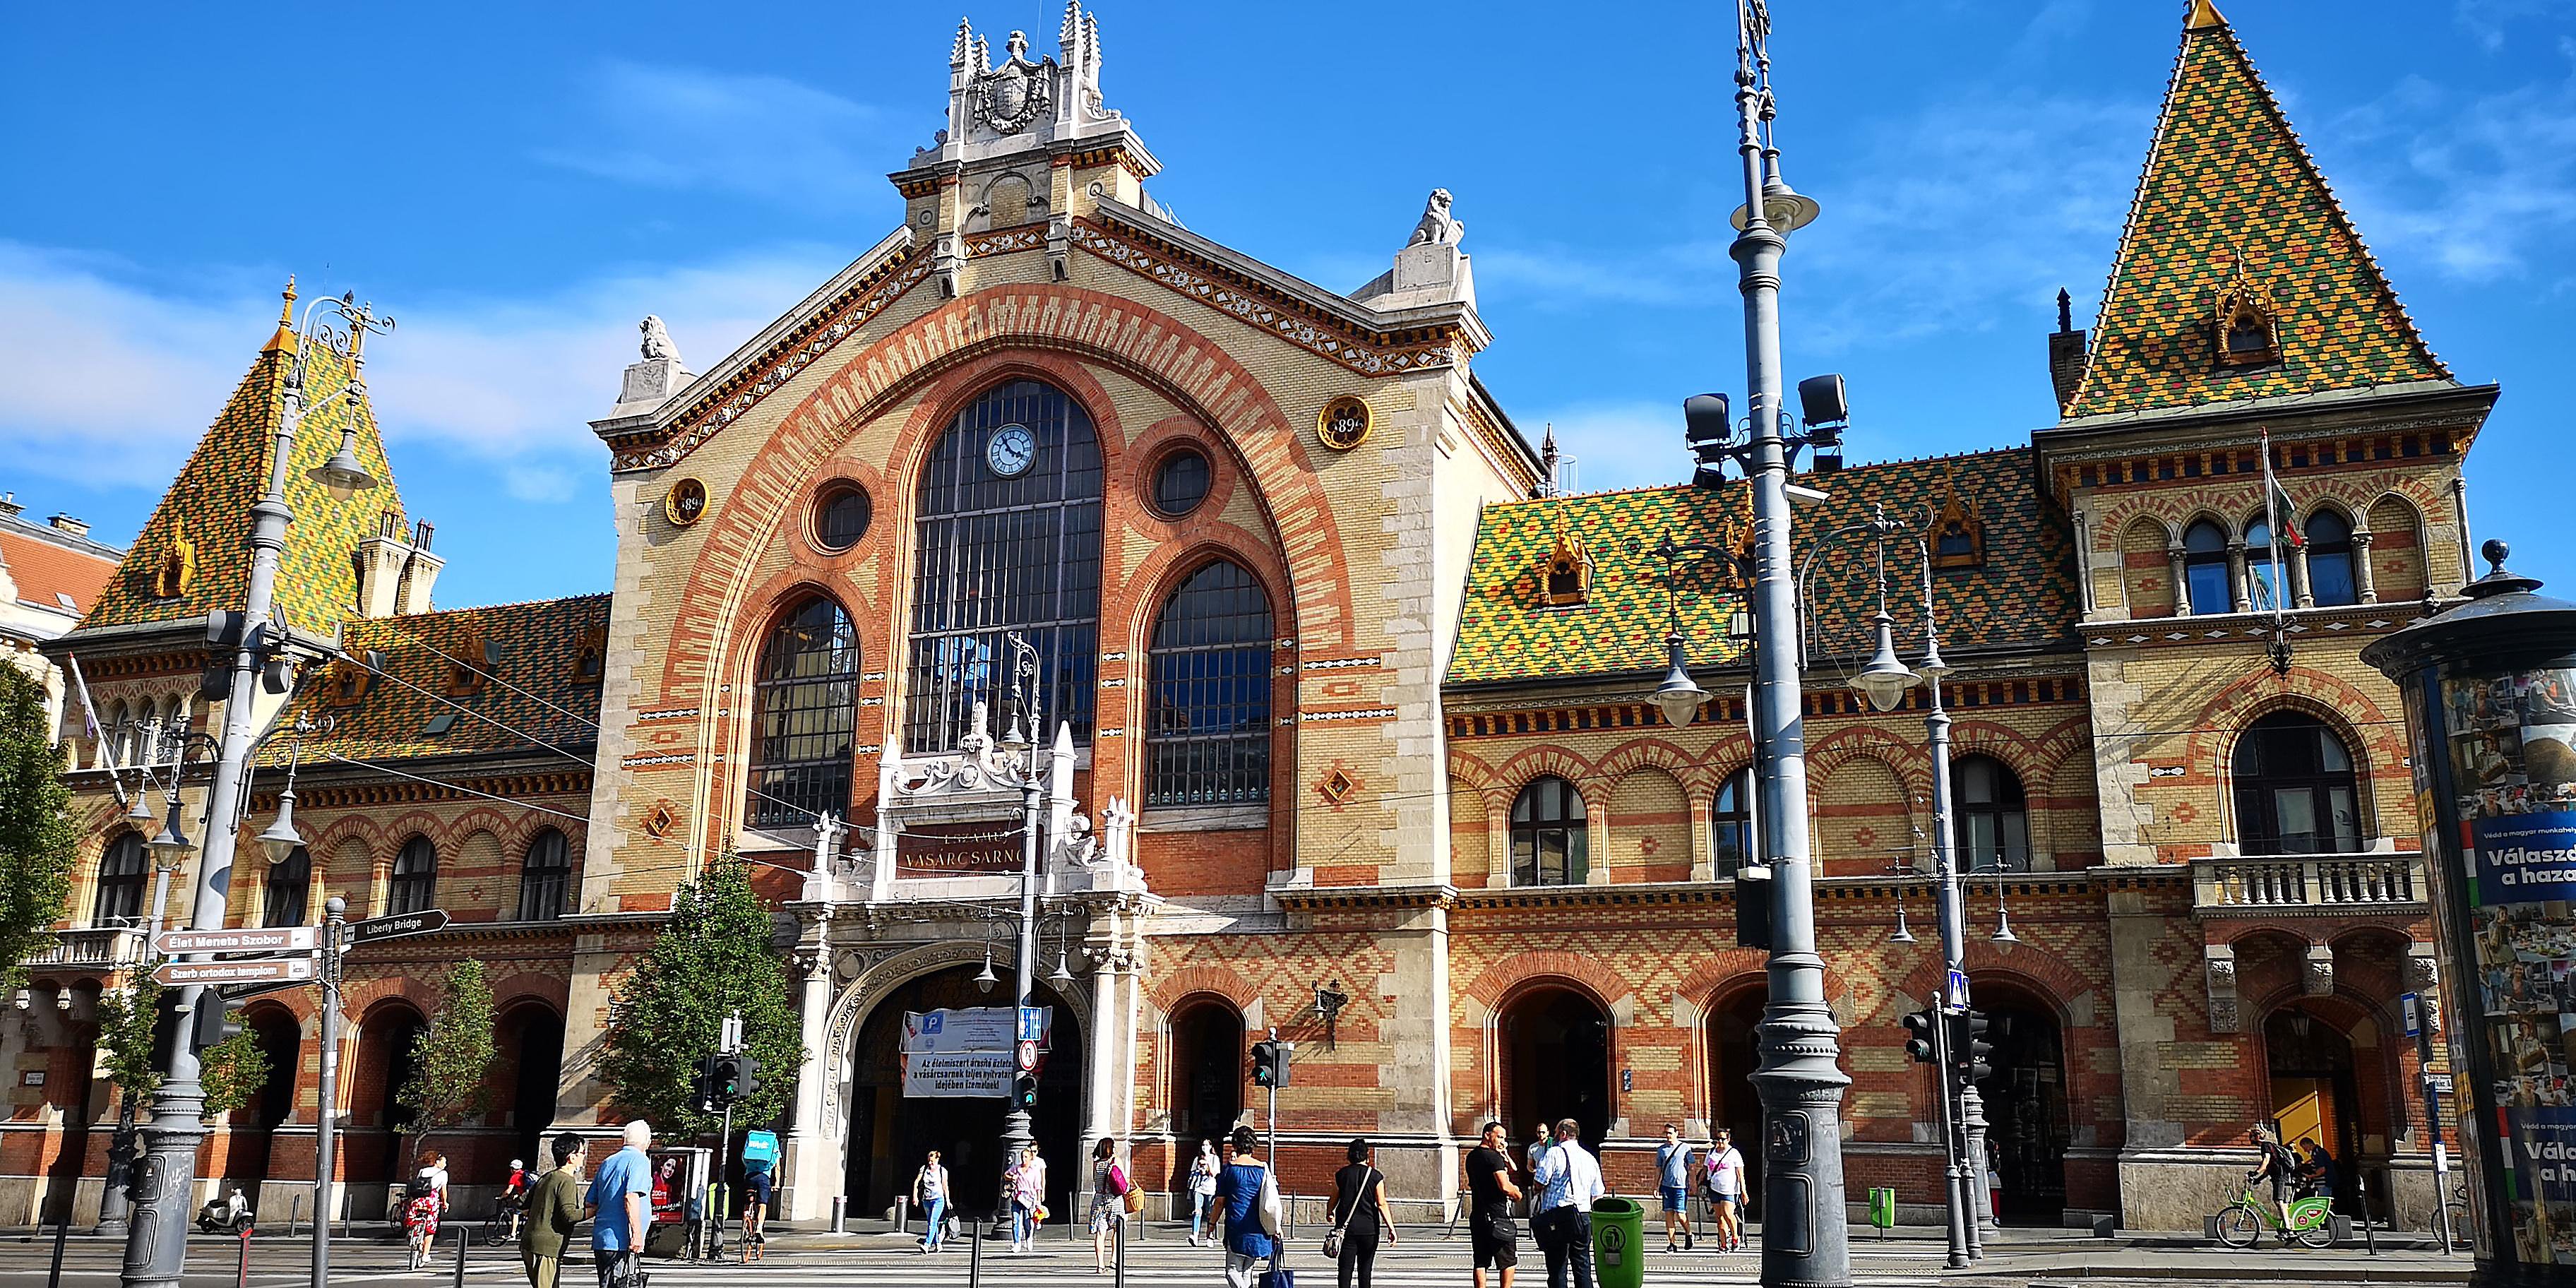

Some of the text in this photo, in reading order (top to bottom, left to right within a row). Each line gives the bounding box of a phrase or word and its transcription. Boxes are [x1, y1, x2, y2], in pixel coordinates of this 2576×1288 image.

[2501, 866, 2576, 885] a haza
[366, 919, 422, 934] Liberty Bridge
[169, 935, 283, 948] Élet Menete Szobor
[170, 965, 278, 979] Szerb ortodox templom
[922, 1059, 929, 1068] Az
[931, 1058, 969, 1068] élelmiszert
[919, 1068, 964, 1079] vásárcsarnok
[965, 1068, 982, 1080] teljes
[935, 1079, 963, 1091] idejében
[2540, 1168, 2556, 1181] a
